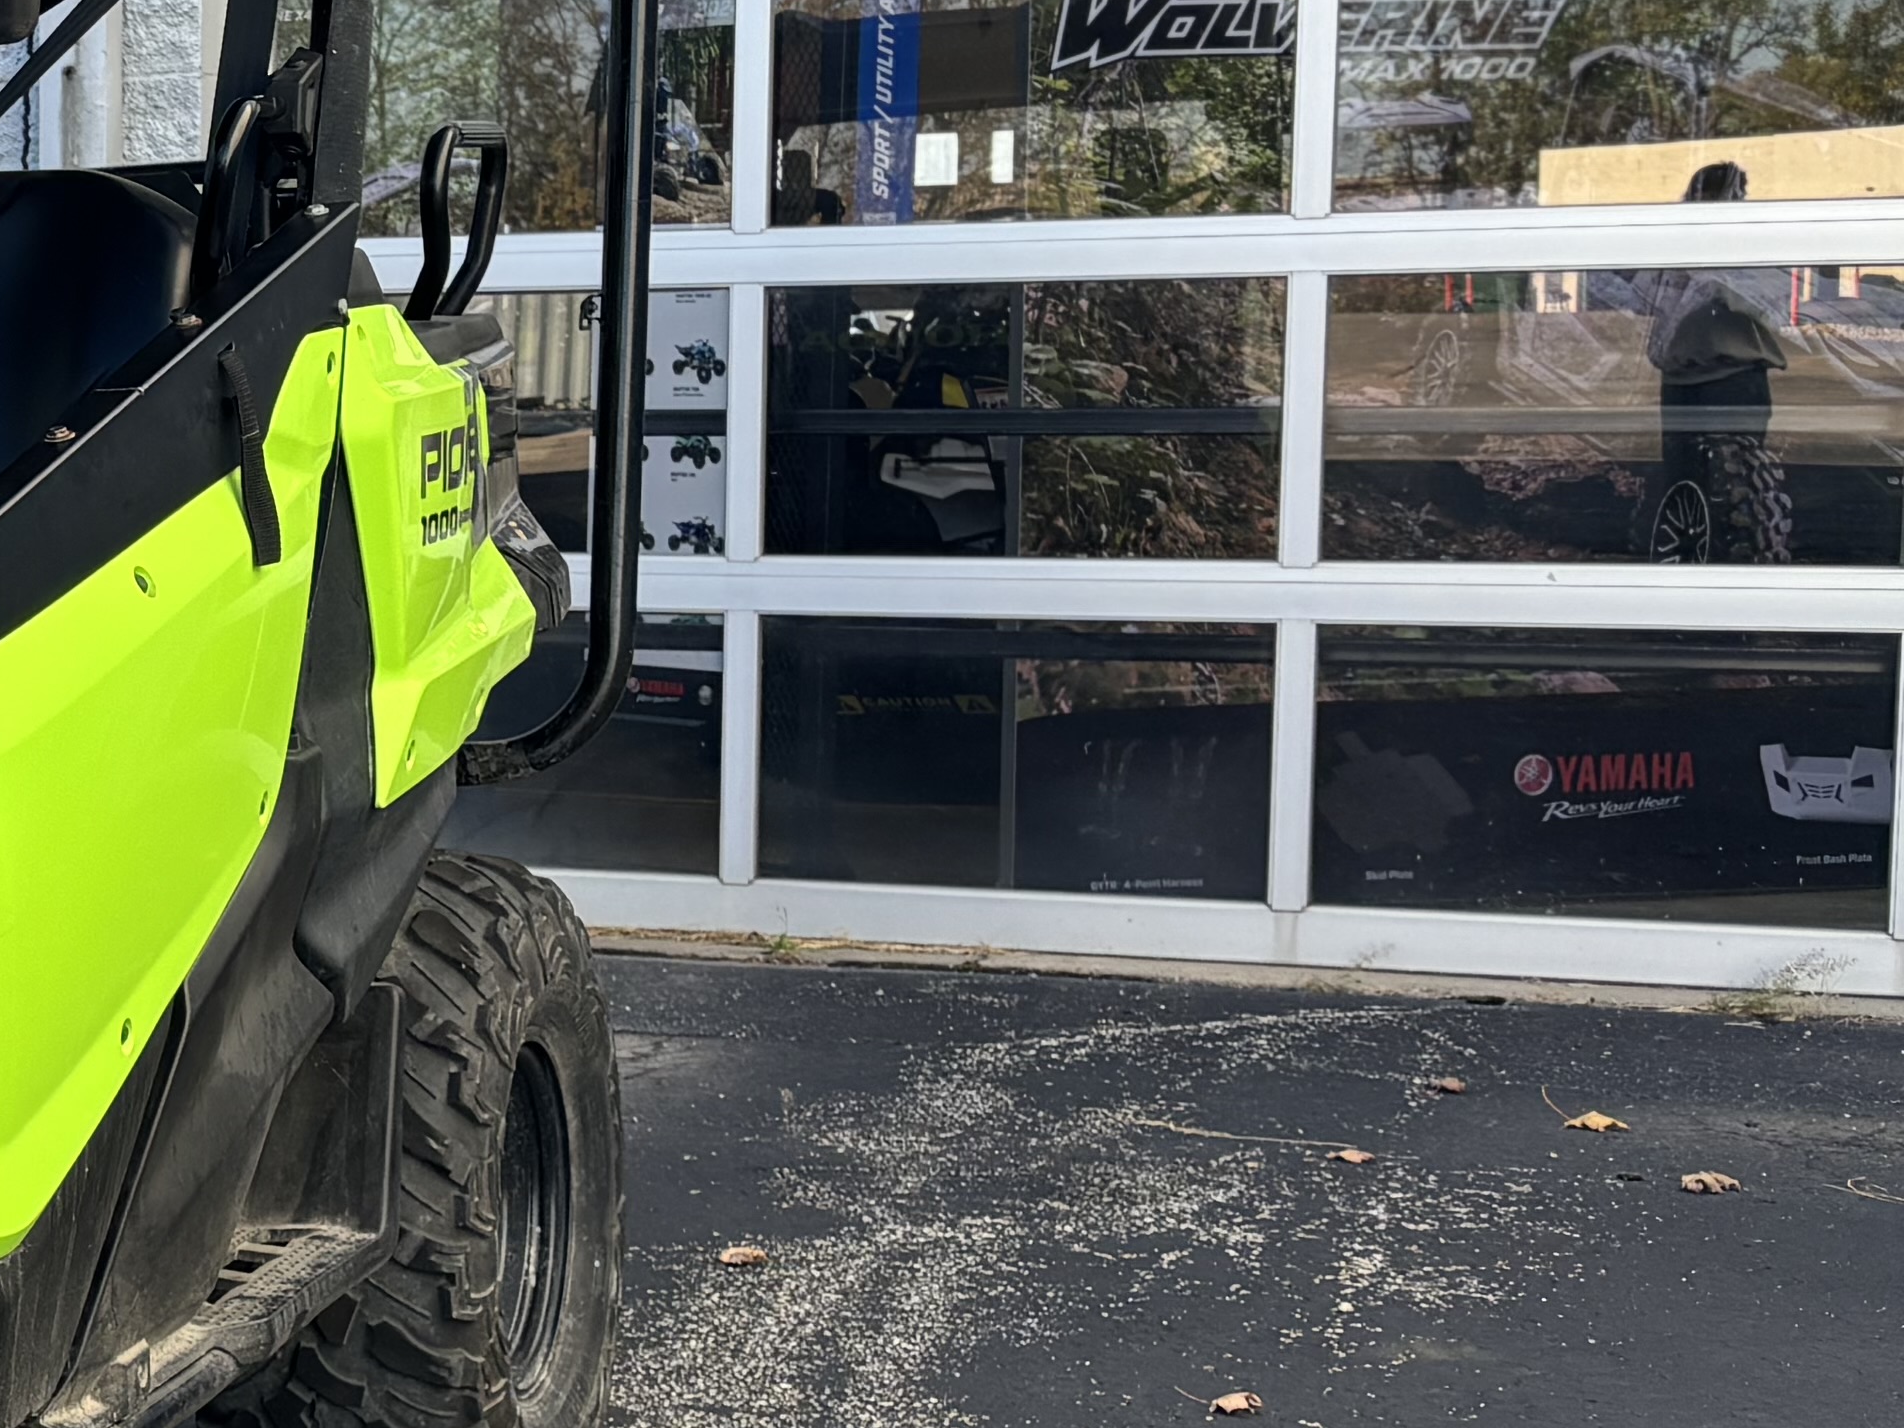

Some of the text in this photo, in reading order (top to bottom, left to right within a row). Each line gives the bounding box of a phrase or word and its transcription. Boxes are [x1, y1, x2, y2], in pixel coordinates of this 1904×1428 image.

[876, 15, 896, 104] UTILITY
[1438, 57, 1535, 79] 1000
[873, 122, 891, 199] SPORT
[1557, 752, 1695, 794] YAMAHA
